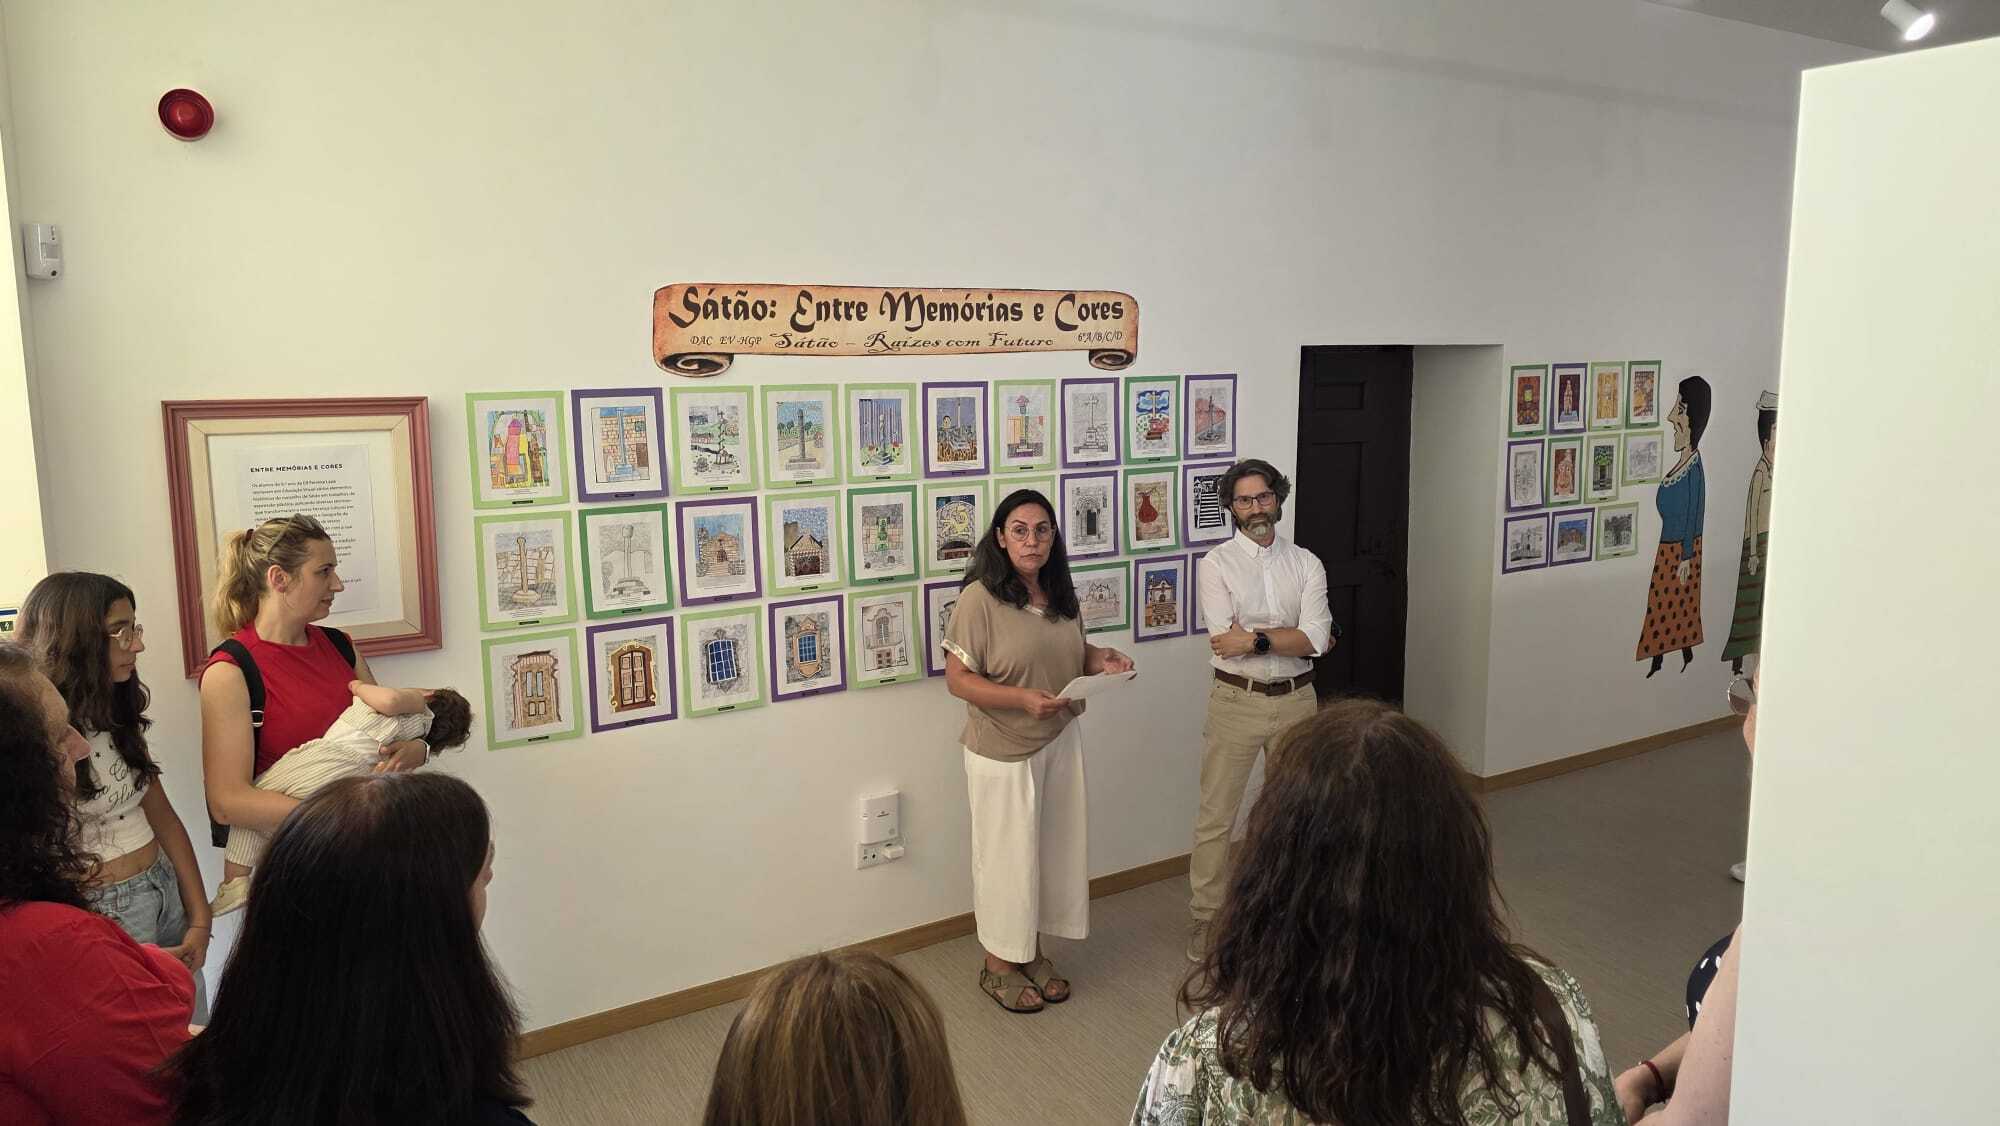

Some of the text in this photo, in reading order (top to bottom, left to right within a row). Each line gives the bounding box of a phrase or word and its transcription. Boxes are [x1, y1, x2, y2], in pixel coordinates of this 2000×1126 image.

[669, 286, 1123, 332] Sátão: Entre Memórias e Cores
[690, 335, 713, 346] DAC
[769, 332, 839, 349] Sátão
[864, 330, 941, 353] Raízes
[945, 339, 980, 347] com
[988, 331, 1053, 347] Futuro
[276, 464, 312, 472] MEMÓRIAS
